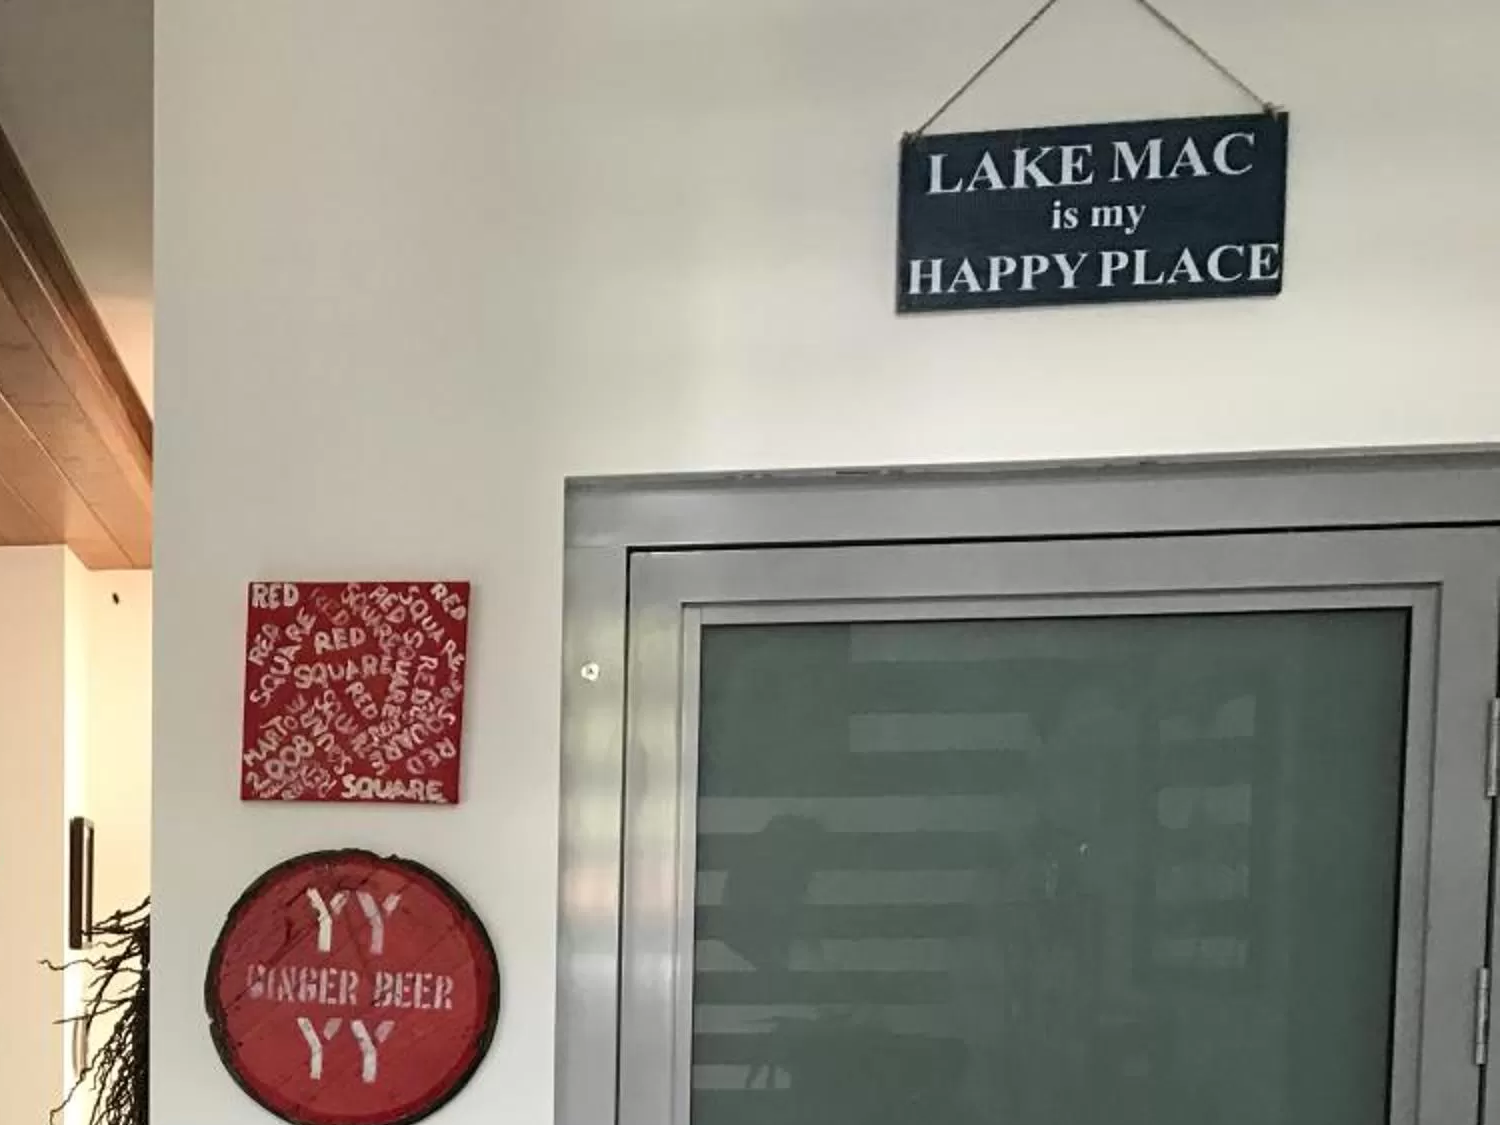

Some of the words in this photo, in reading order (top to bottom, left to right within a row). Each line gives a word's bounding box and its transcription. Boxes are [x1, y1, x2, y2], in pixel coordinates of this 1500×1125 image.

[926, 143, 1095, 195] LAKE
[1108, 132, 1257, 183] MAC
[1051, 200, 1079, 230] is
[1090, 203, 1146, 235] my
[907, 252, 1088, 295] HAPPY
[1097, 243, 1281, 287] PLACE
[251, 583, 299, 609] RED
[430, 583, 467, 621] RED
[313, 627, 367, 655] RED
[292, 654, 393, 689] SQUARE
[340, 773, 450, 803] SQUARE
[306, 887, 401, 954] YY
[247, 963, 359, 1005] GINGER
[373, 970, 454, 1009] BEER
[296, 1016, 396, 1084] YY
